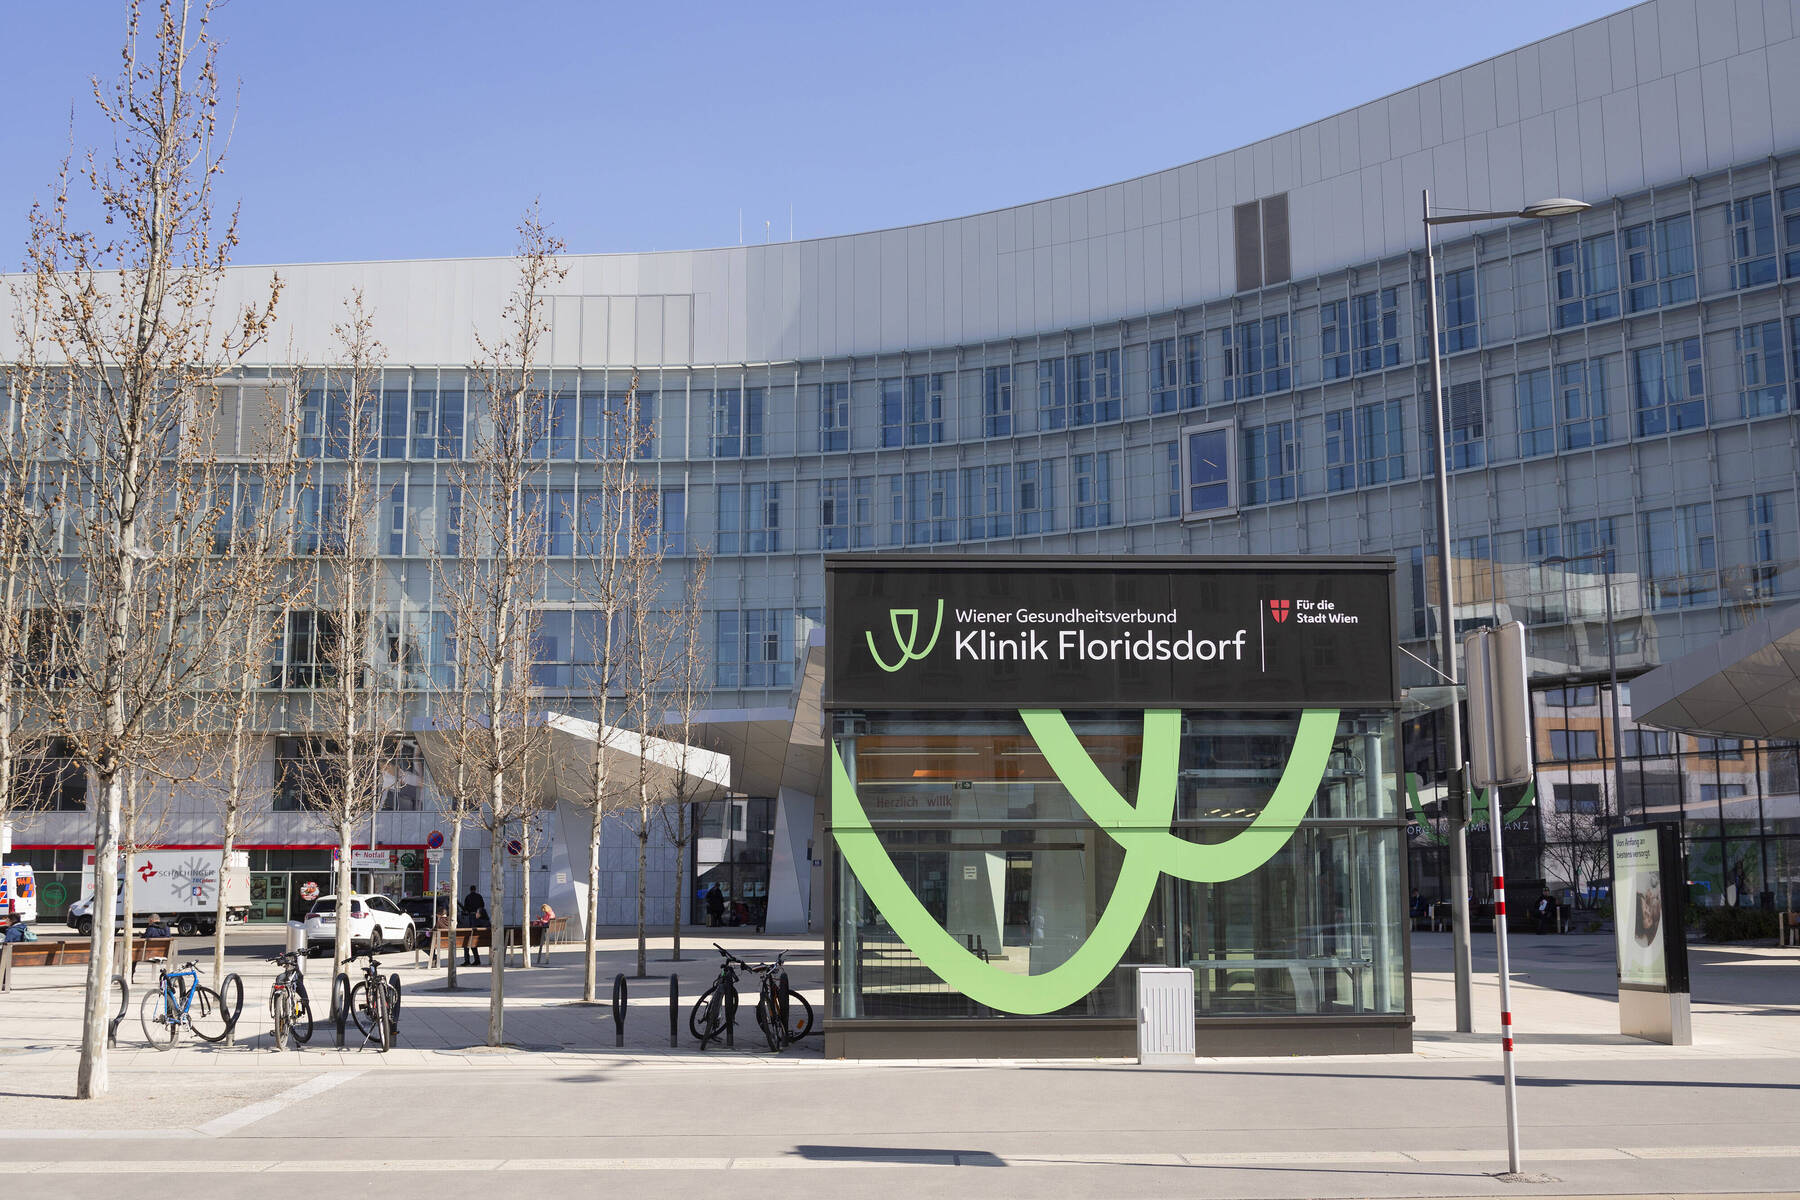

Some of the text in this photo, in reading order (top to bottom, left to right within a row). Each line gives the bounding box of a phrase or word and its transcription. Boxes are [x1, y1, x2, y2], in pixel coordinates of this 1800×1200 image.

[1296, 600, 1335, 610] Für die
[955, 608, 1177, 623] Wiener Gesundheitsverbund
[1296, 613, 1358, 624] Stadt Wien
[955, 629, 1246, 661] Klinik Floridsdorf
[876, 796, 918, 808] Herzlich
[1616, 839, 1624, 847] Von
[1625, 837, 1640, 848] Anfang
